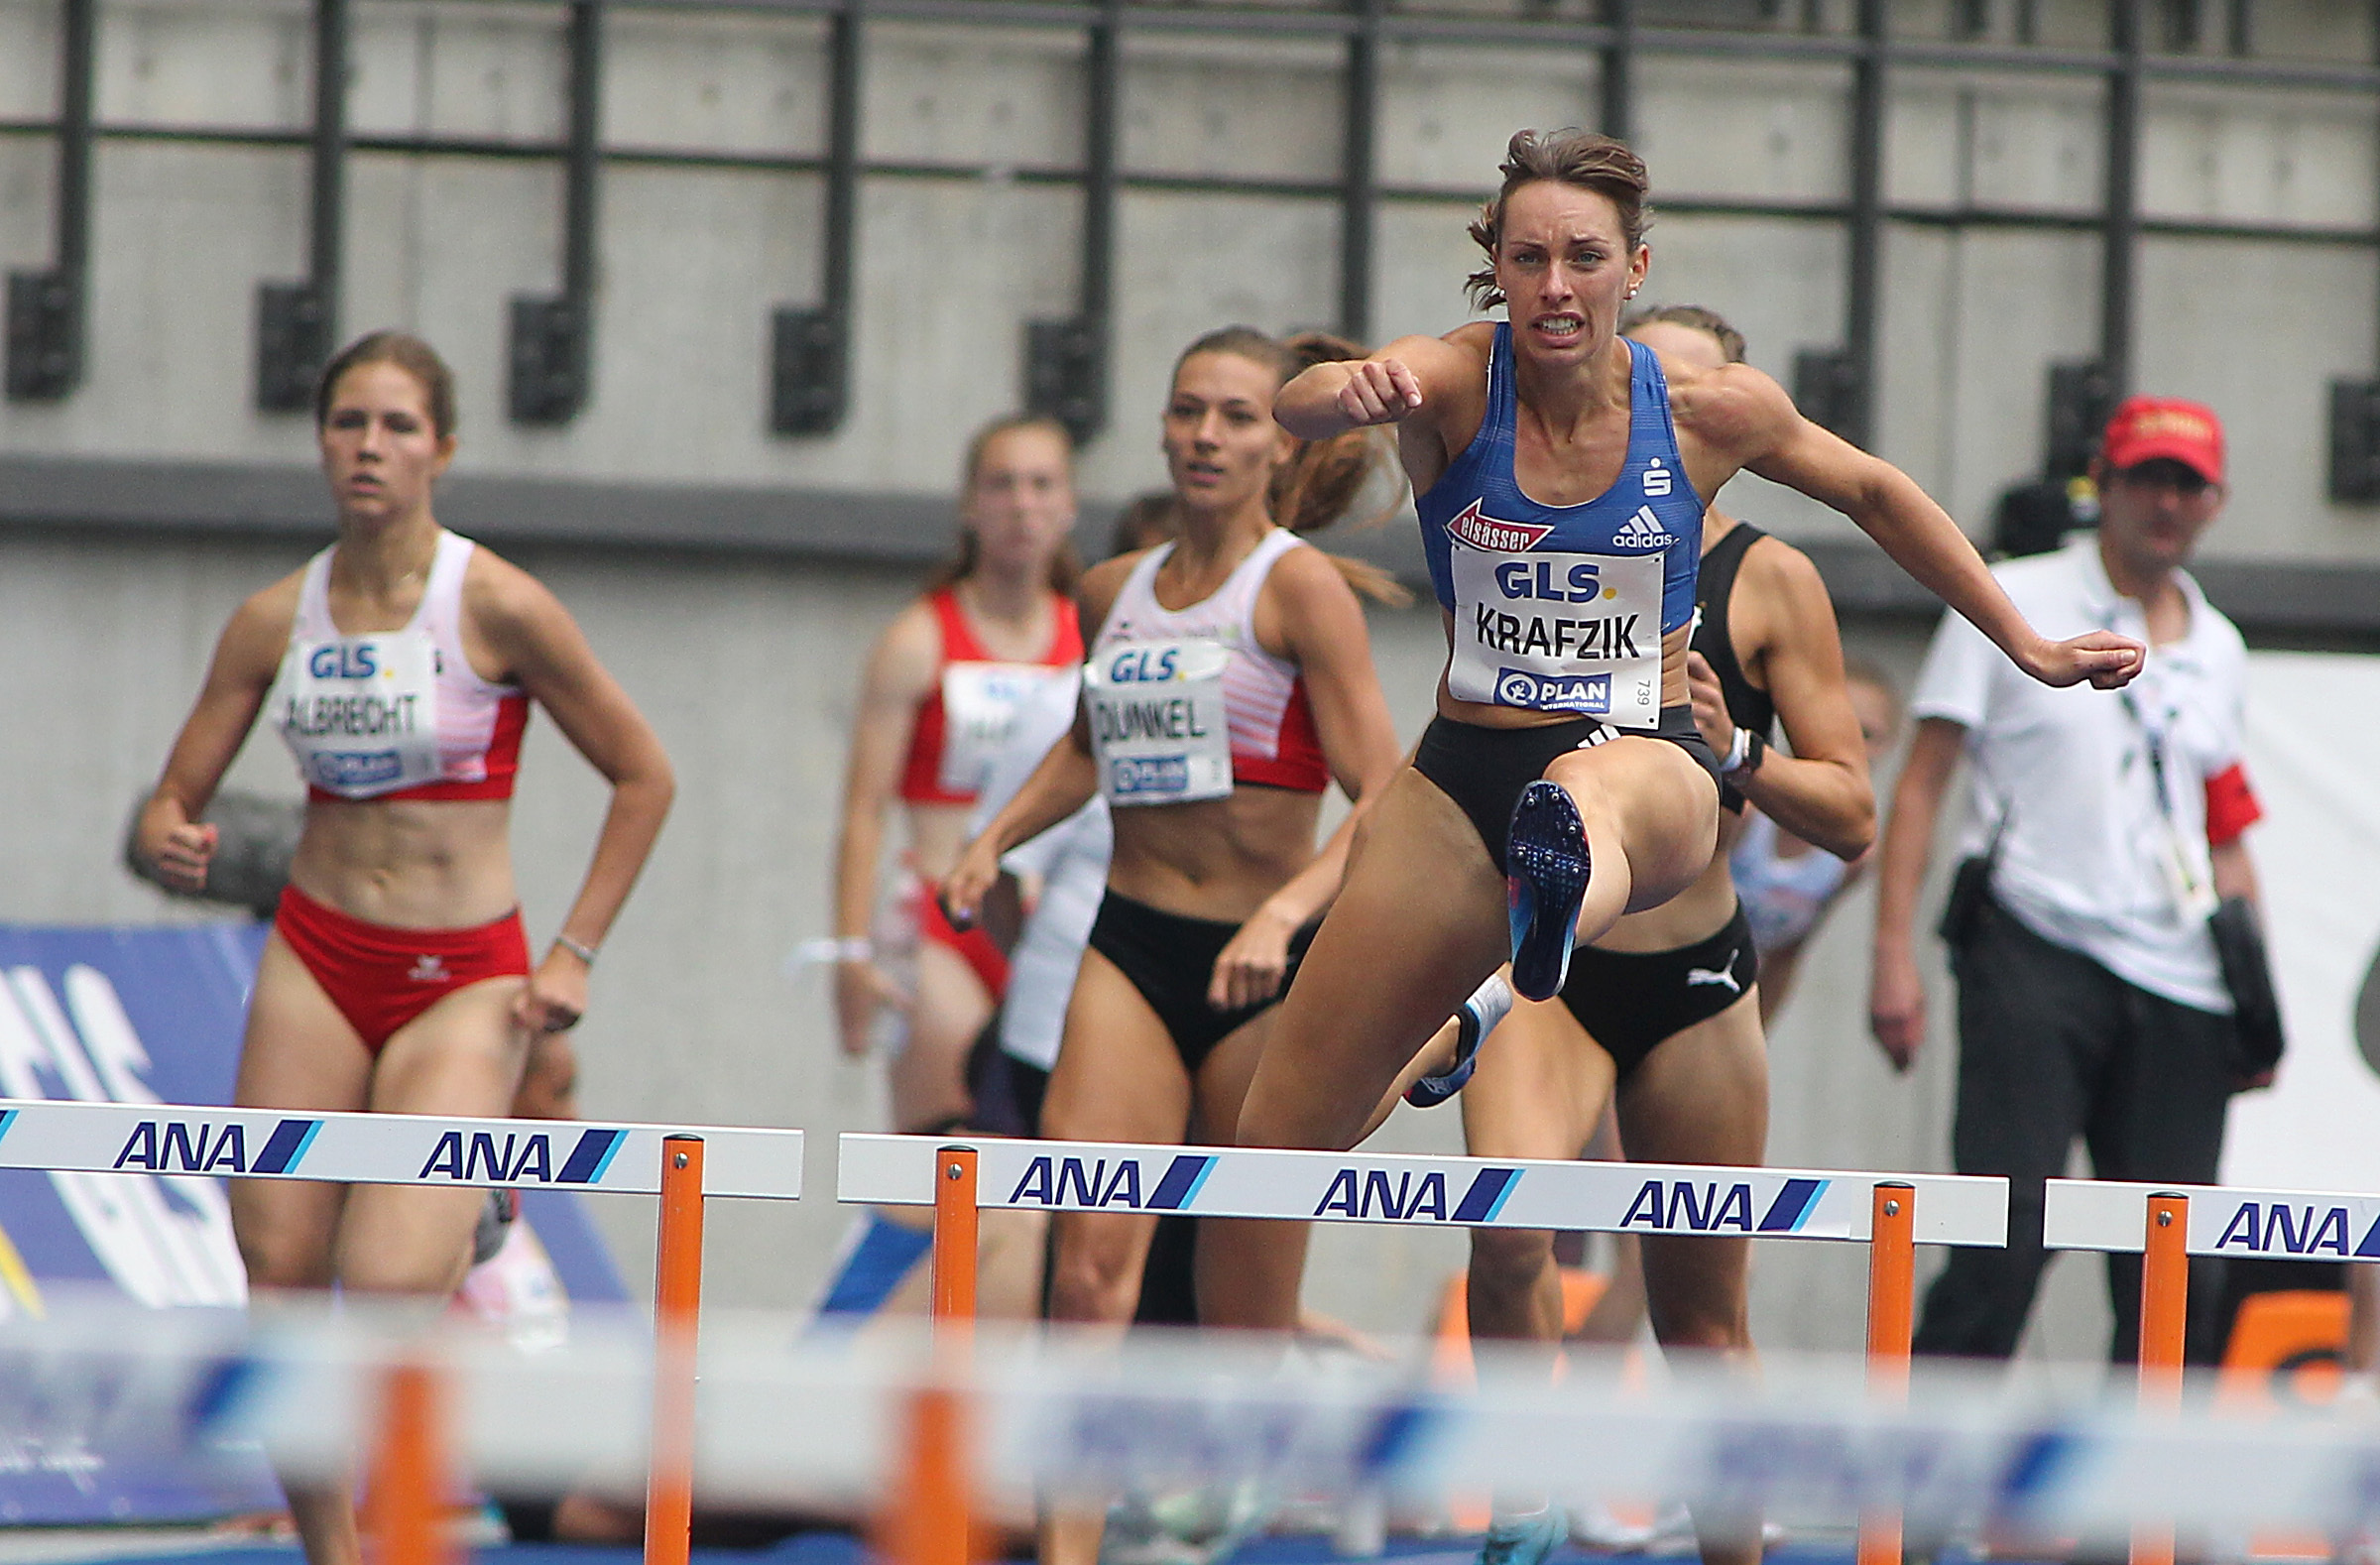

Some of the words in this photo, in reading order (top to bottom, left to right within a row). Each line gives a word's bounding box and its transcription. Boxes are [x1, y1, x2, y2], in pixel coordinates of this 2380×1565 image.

[1461, 515, 1530, 551] elsässer
[1612, 533, 1673, 548] adidas
[1476, 601, 1641, 660] KRAFZIK
[1539, 681, 1606, 701] PLAN
[1540, 700, 1605, 710] INTERNATIONAL
[1637, 679, 1651, 705] 739
[284, 695, 417, 736] ALBRECHT
[1098, 699, 1207, 741] DUNKEL
[111, 1121, 247, 1173] ANA
[417, 1131, 552, 1182] ANA
[1008, 1155, 1141, 1207] ANA
[1313, 1168, 1448, 1221] ANA
[1618, 1180, 1753, 1232] ANA
[2214, 1202, 2350, 1257] ANA
